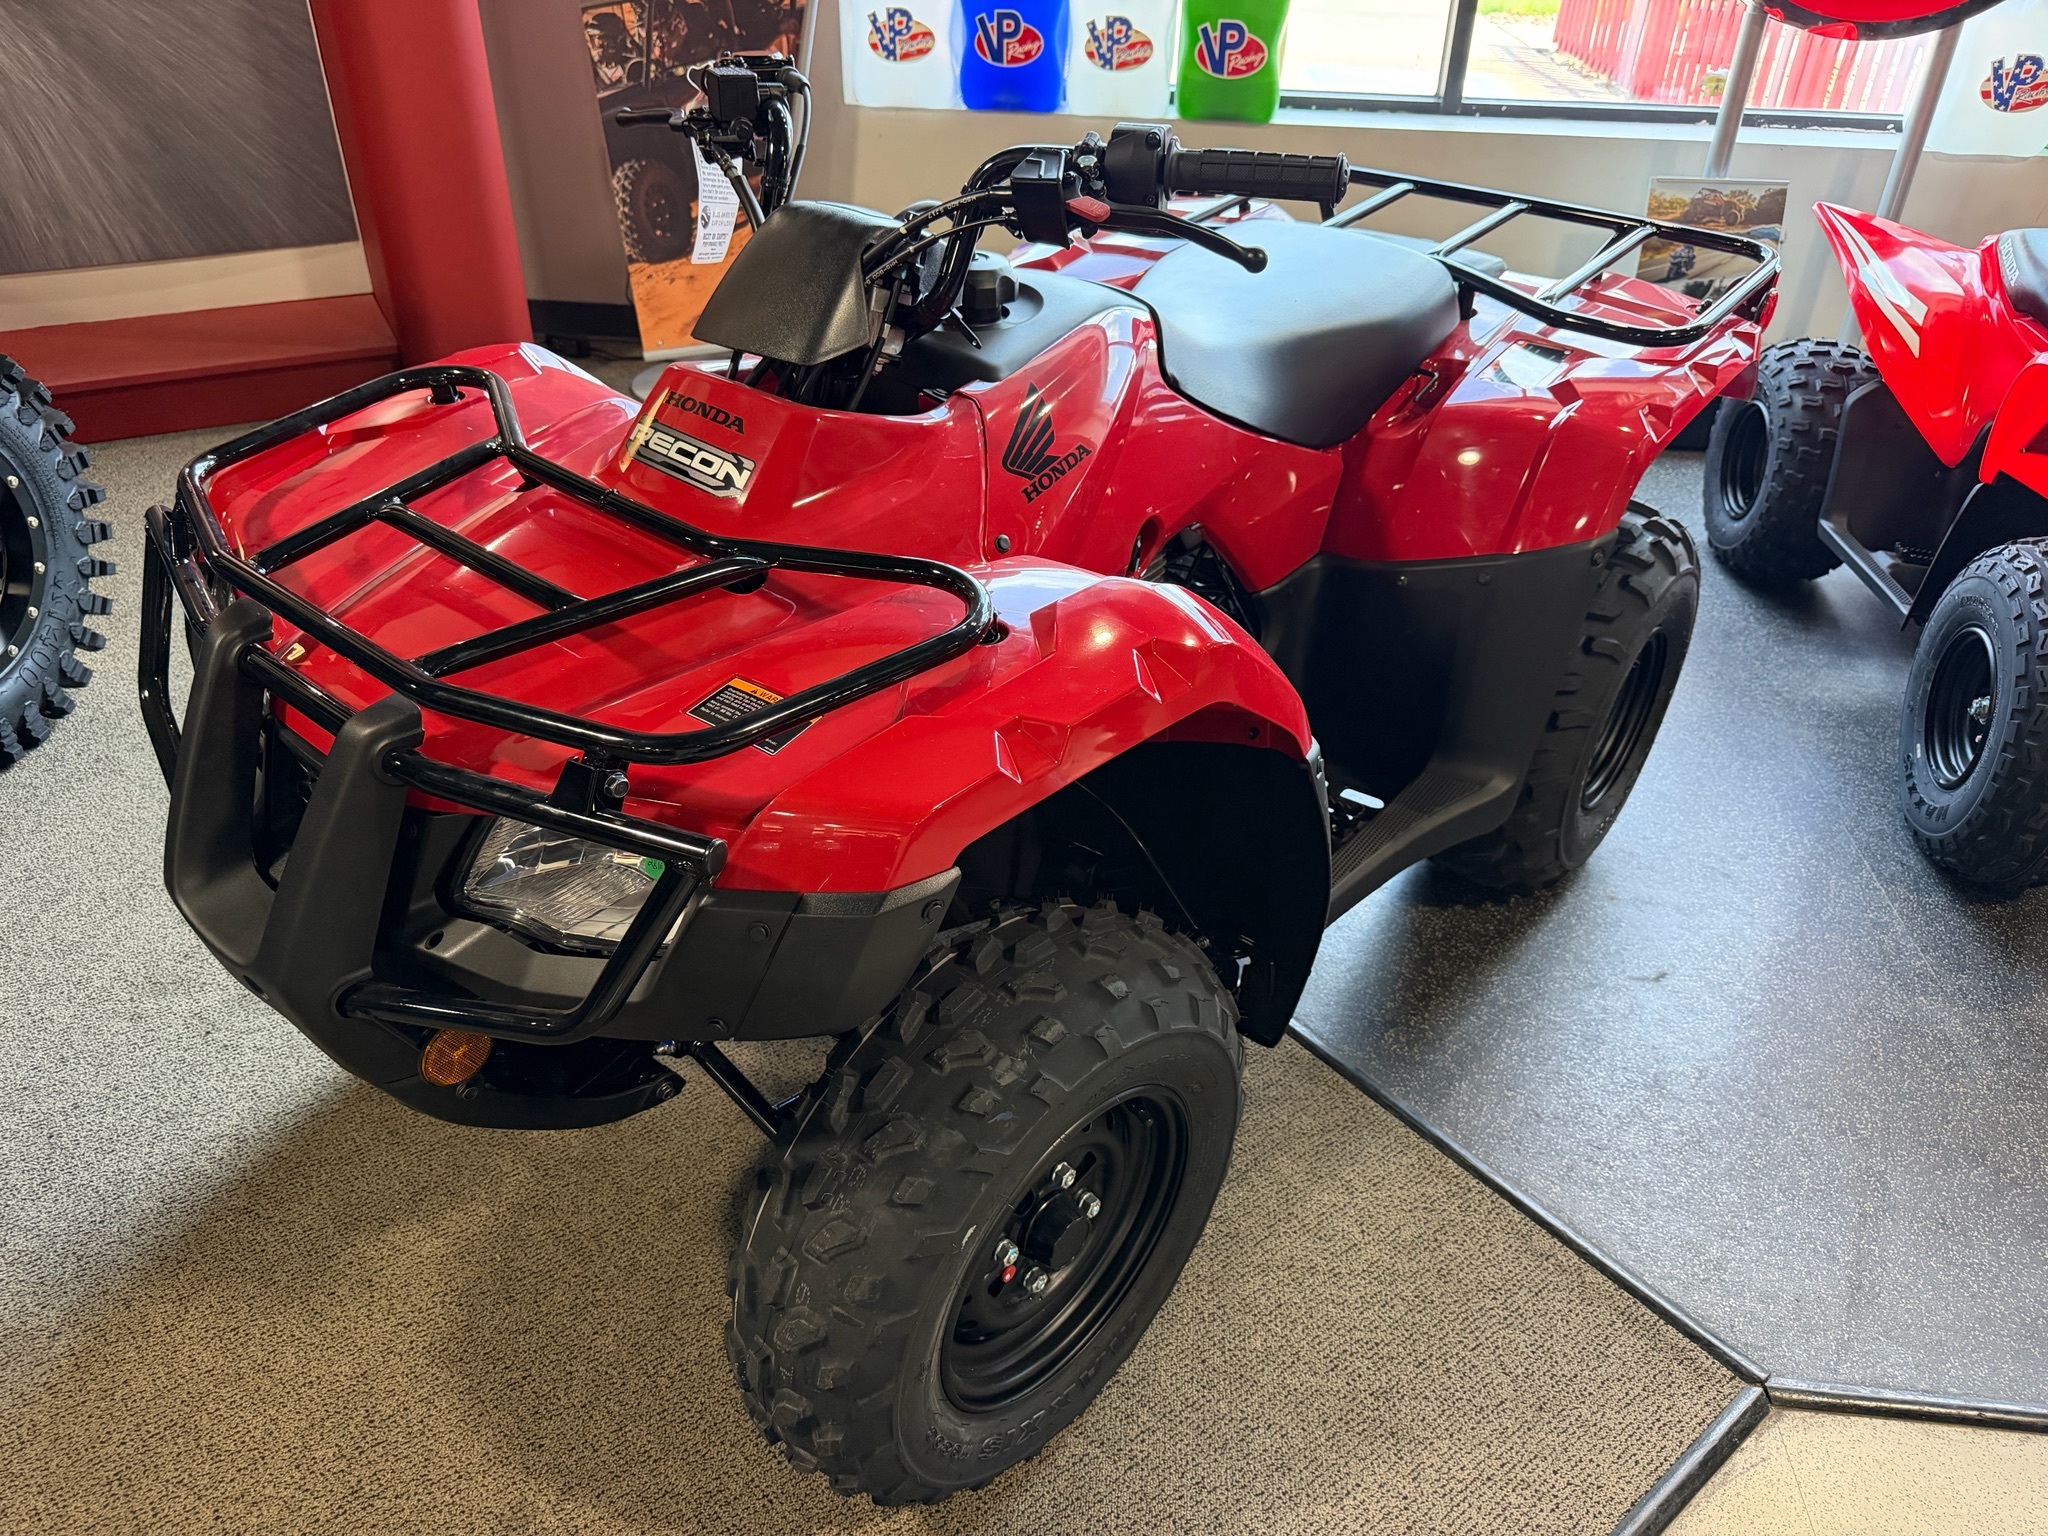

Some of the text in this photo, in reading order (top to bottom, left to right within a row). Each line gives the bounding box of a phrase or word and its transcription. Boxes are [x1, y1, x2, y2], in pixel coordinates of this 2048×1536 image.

[867, 7, 913, 61] VP
[976, 10, 1023, 65] VP
[1007, 40, 1042, 61] Racing
[1086, 15, 1132, 70] VP
[1199, 20, 1247, 76] VP
[1228, 51, 1264, 72] Racing
[1991, 53, 2044, 112] VP
[2000, 237, 2020, 287] HONDA
[664, 391, 744, 435] HONDA
[630, 422, 752, 490] RECON
[1021, 443, 1092, 504] HONDA
